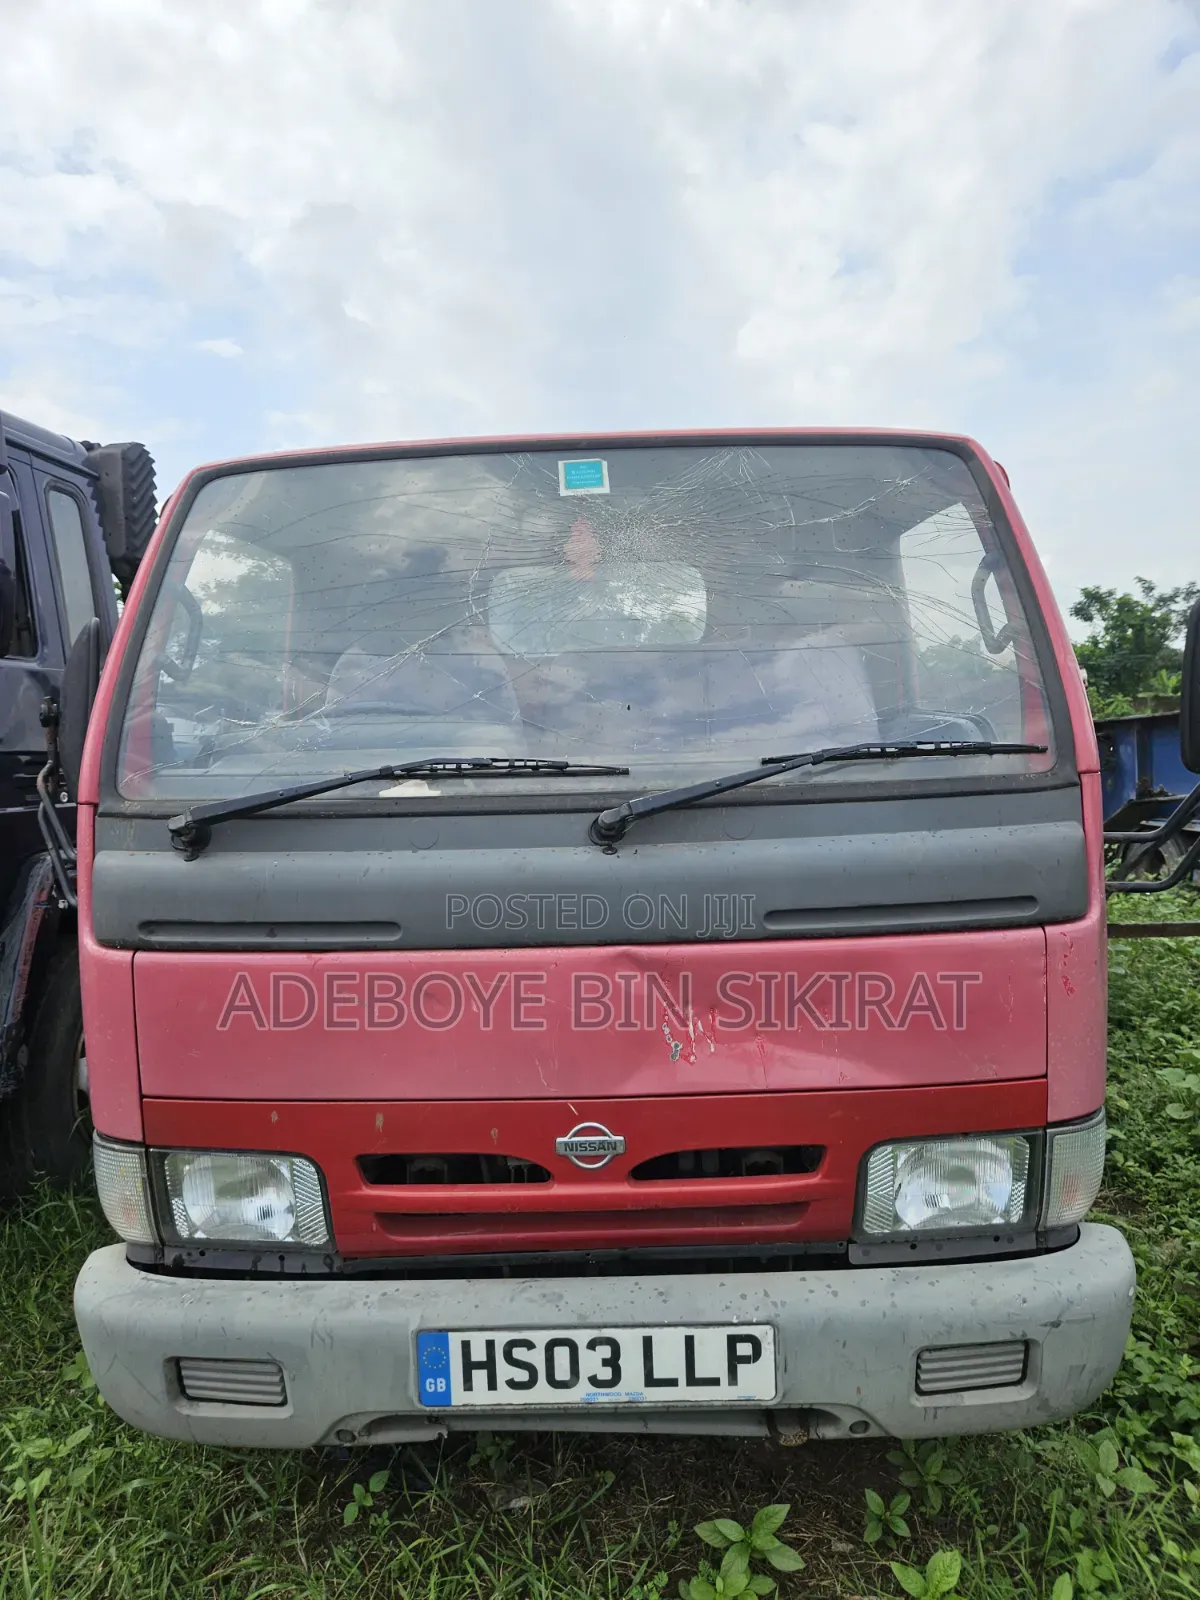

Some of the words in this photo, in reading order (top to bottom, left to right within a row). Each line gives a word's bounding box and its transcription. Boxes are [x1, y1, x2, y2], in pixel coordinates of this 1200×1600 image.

[564, 1140, 617, 1152] NISSAN
[461, 1336, 622, 1391] HS03
[642, 1334, 763, 1388] LLP
[425, 1378, 448, 1394] GB
